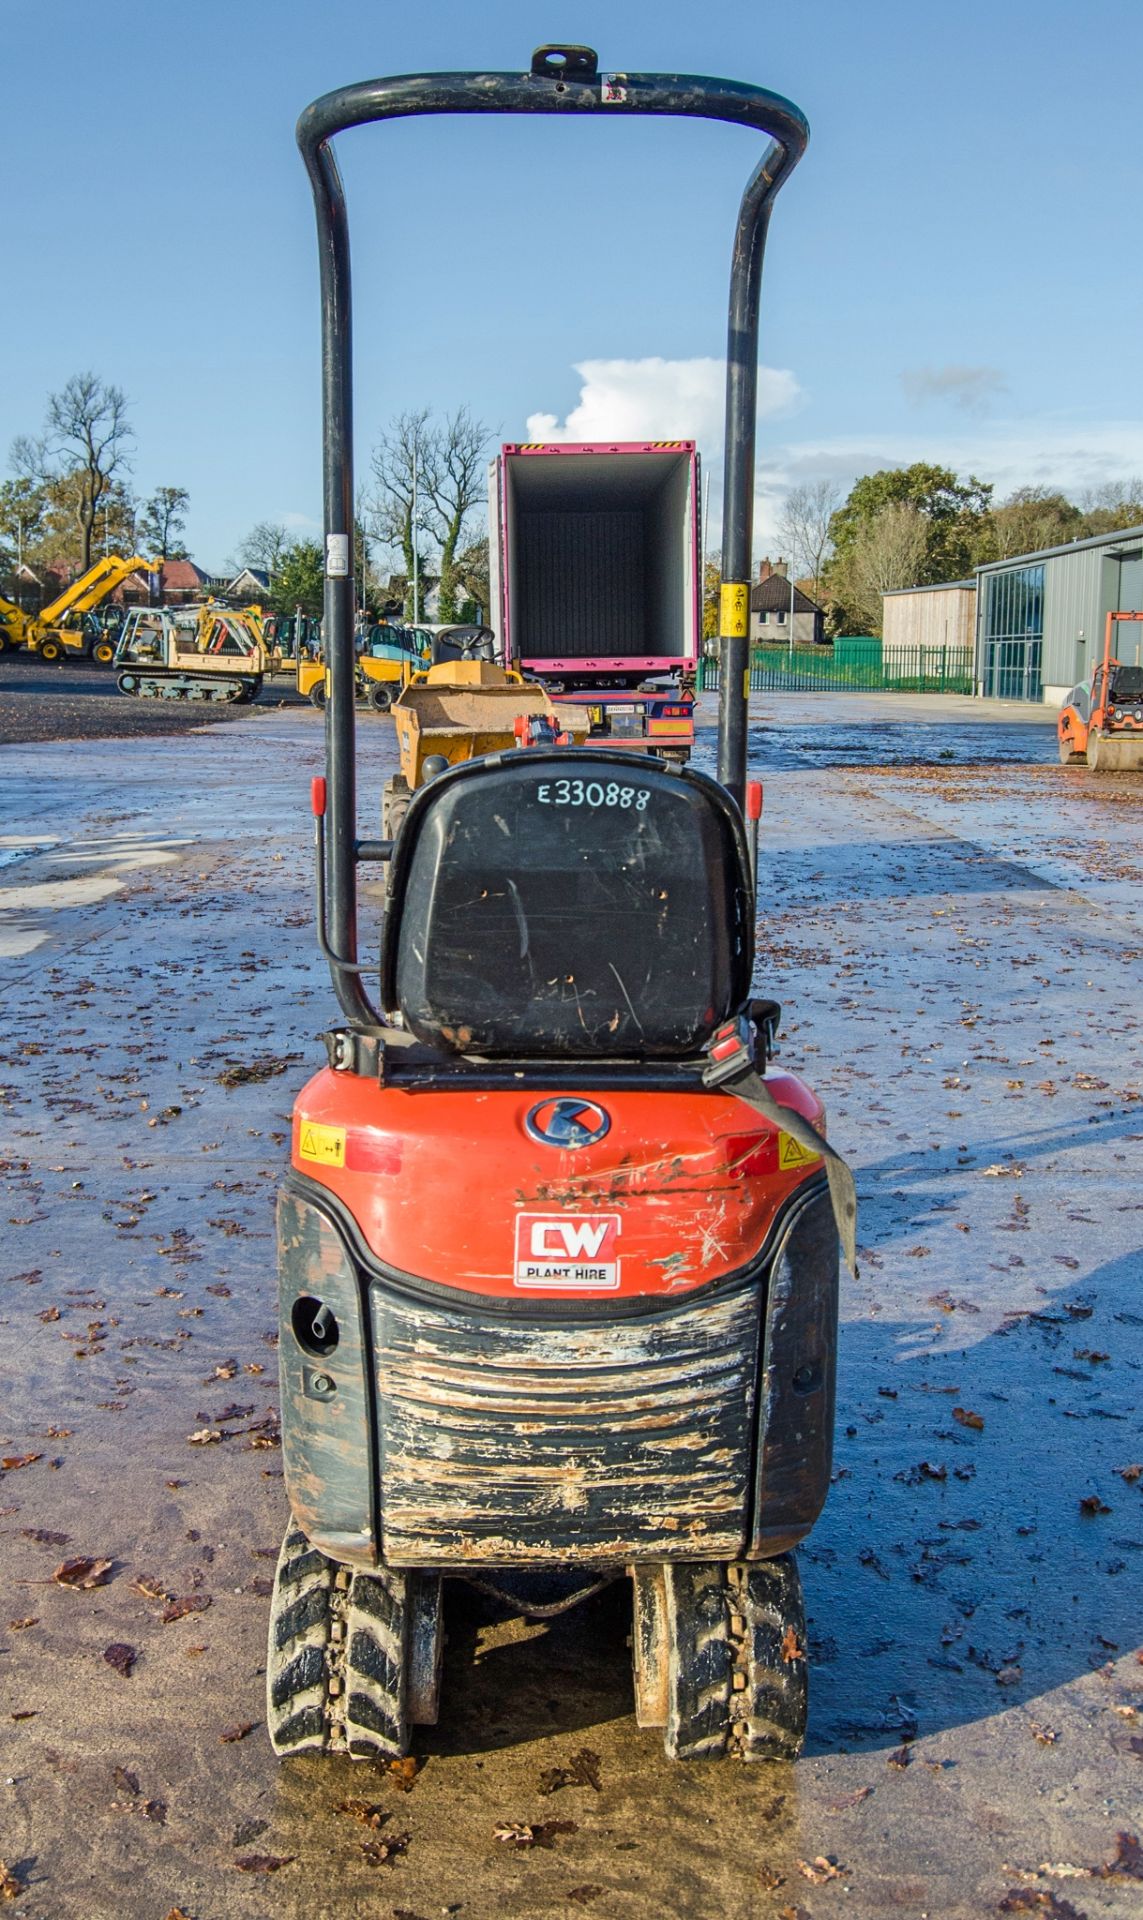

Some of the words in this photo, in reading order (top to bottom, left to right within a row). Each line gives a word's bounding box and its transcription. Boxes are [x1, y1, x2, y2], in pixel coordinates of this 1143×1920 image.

[537, 779, 651, 811] E330888
[530, 1222, 609, 1258] CW
[526, 1267, 571, 1278] PLANT
[575, 1269, 607, 1280] HIRE
